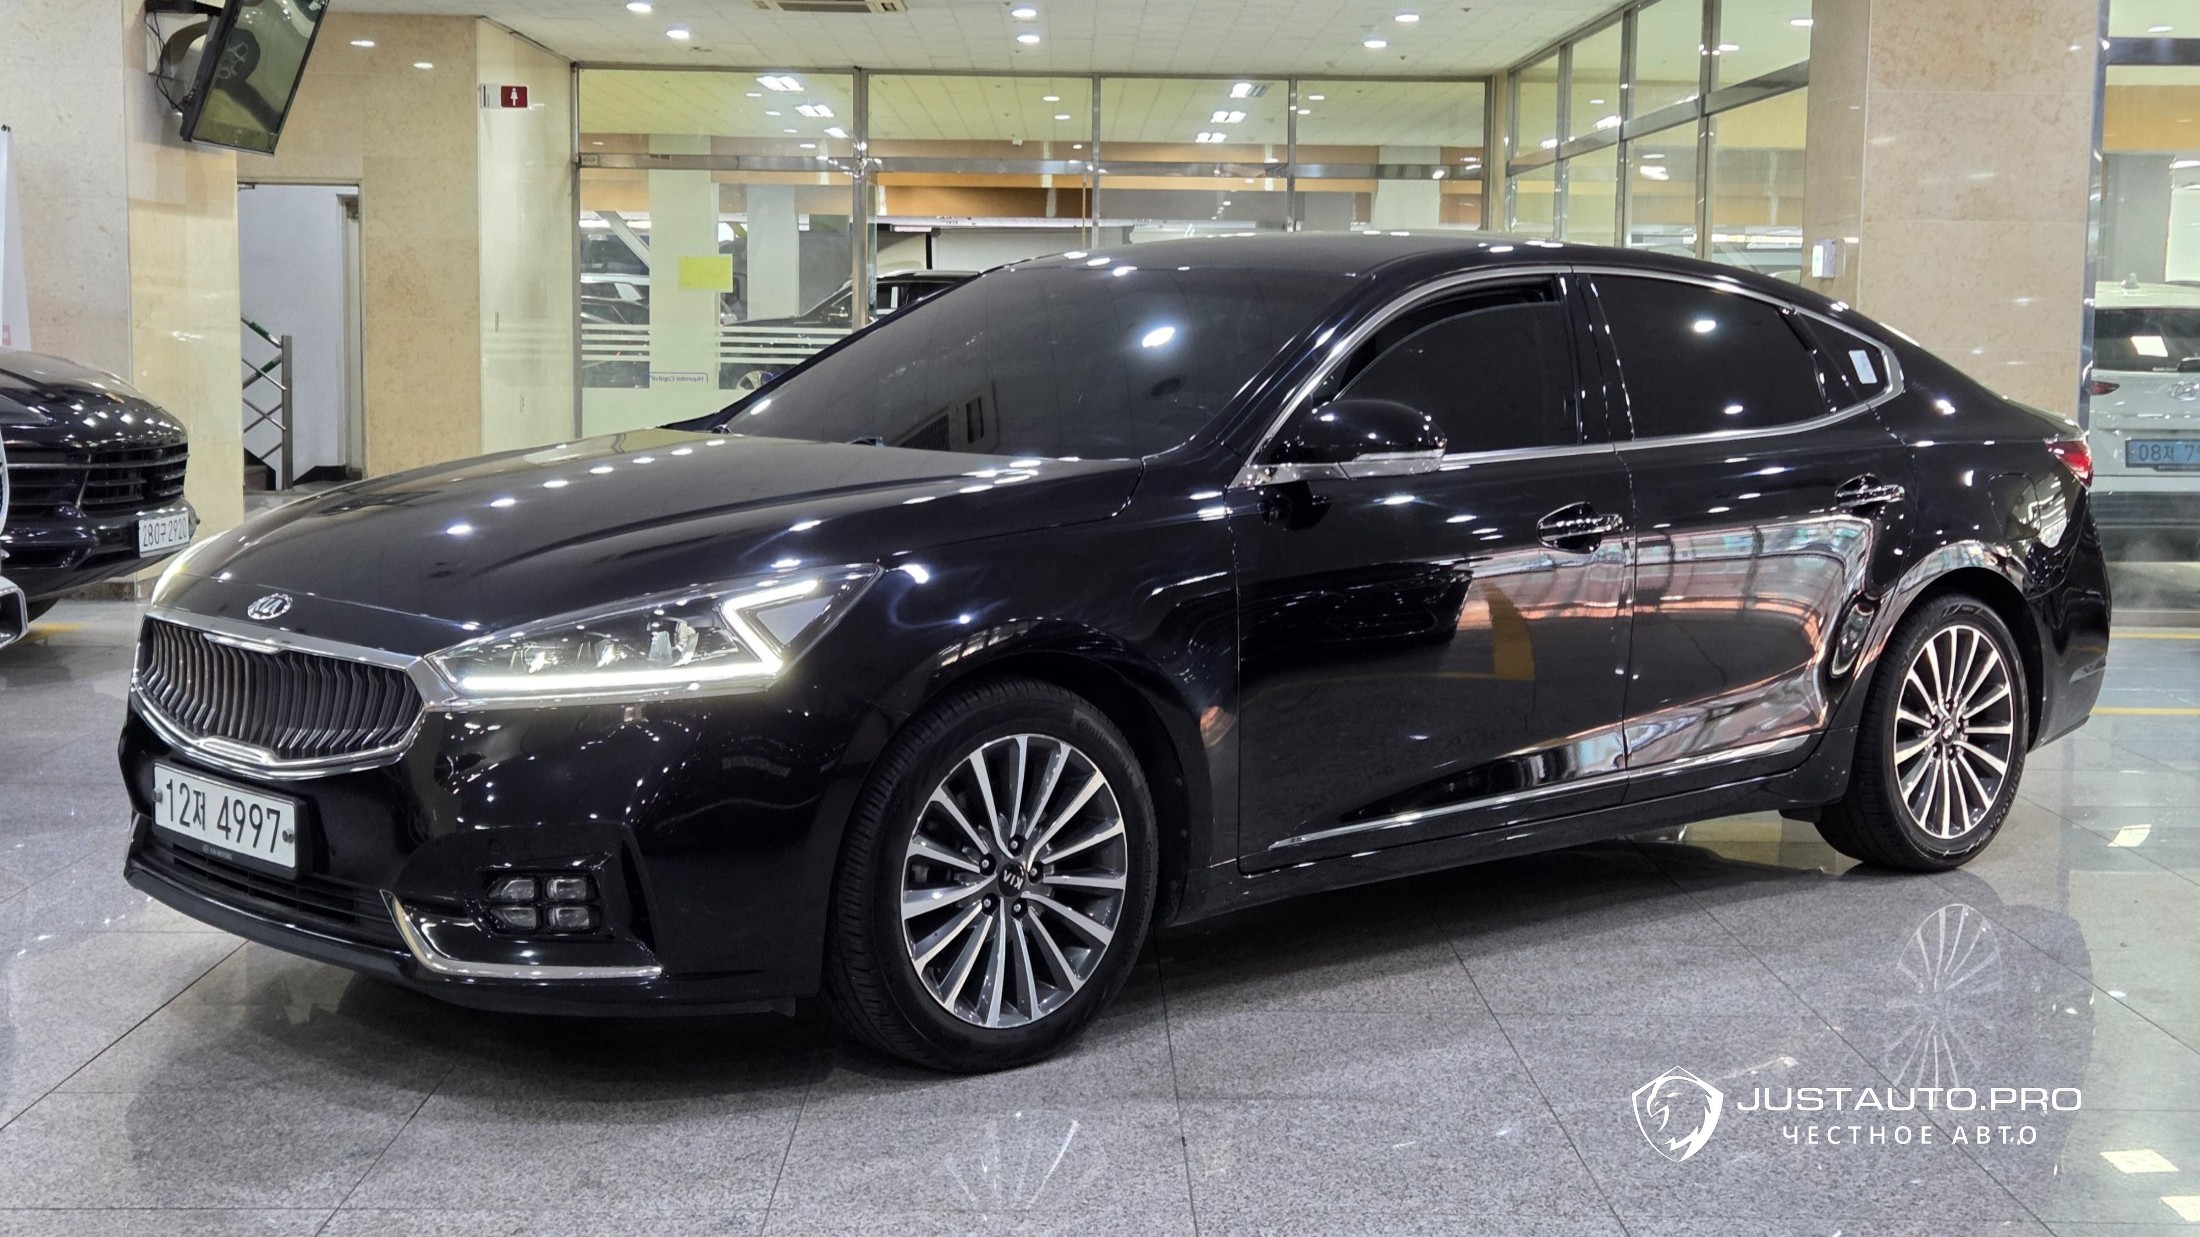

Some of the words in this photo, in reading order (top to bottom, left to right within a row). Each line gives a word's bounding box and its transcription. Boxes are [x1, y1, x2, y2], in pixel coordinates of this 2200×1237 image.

[166, 779, 206, 831] 12저
[217, 795, 281, 854] 4997
[1003, 869, 1024, 890] KIA
